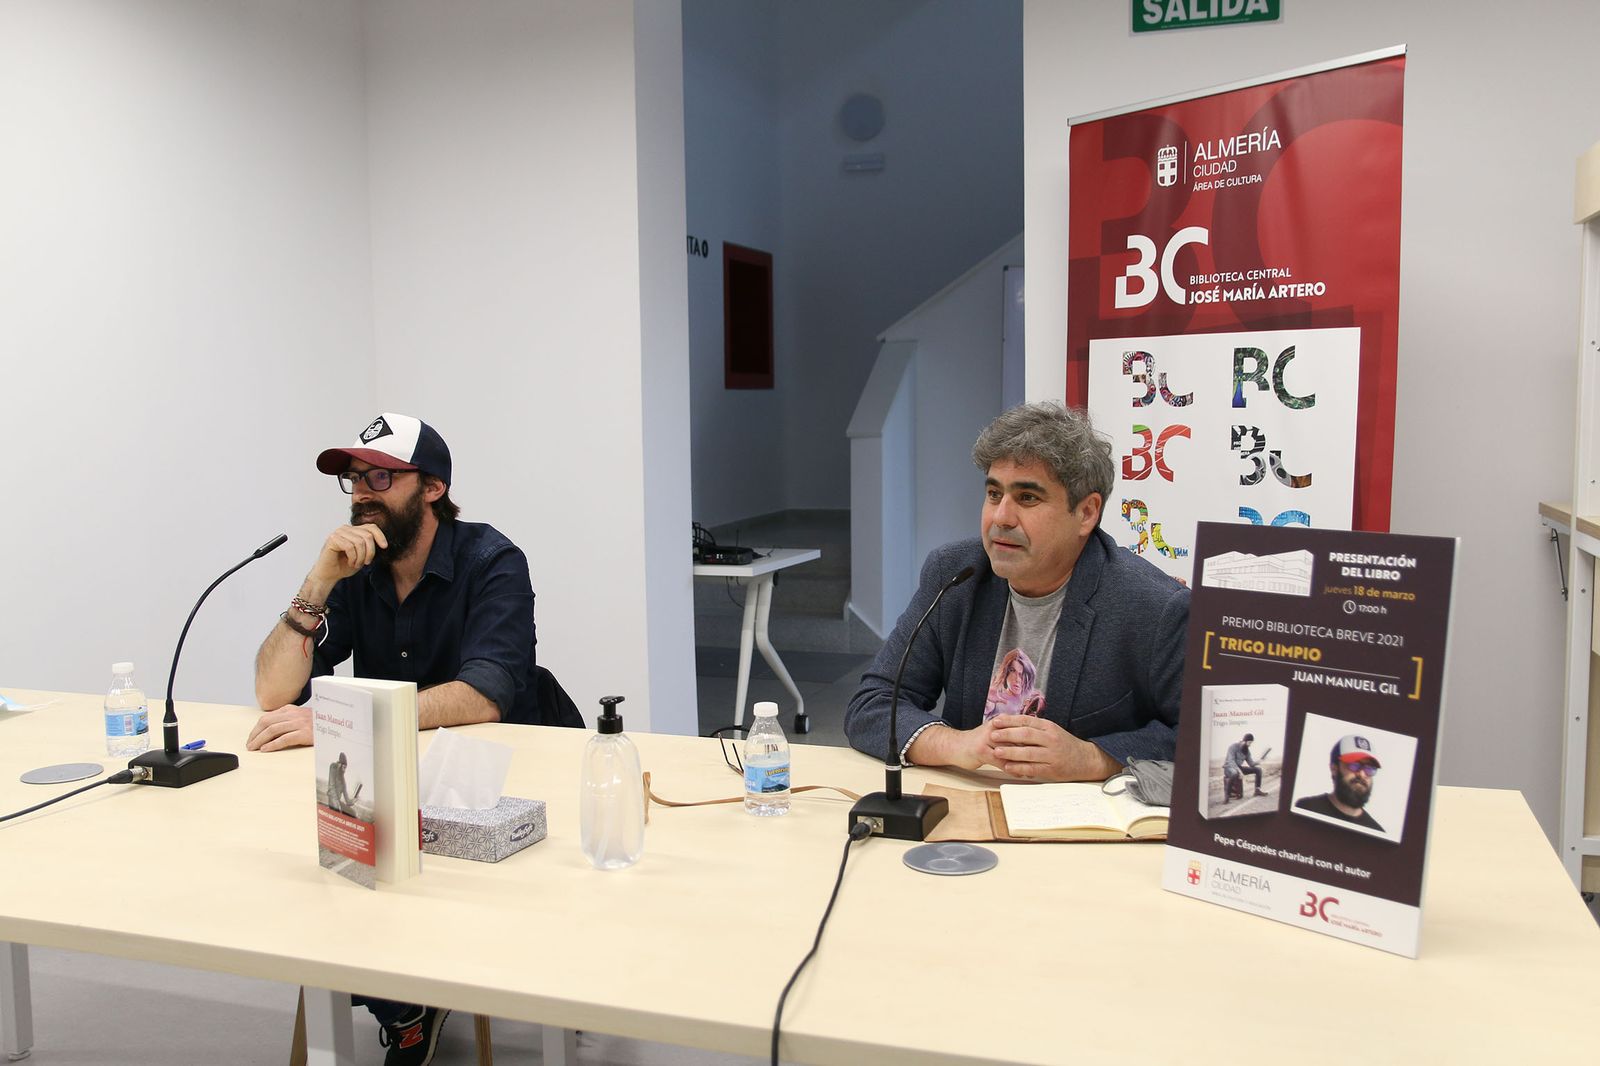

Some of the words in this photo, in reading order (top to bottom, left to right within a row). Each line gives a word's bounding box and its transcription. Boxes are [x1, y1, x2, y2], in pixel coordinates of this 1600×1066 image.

[1142, 0, 1269, 24] SALIDA
[1193, 126, 1282, 163] ALMERÍA
[1192, 160, 1237, 178] CIUDAD
[1192, 181, 1213, 192] ÁREA
[1214, 180, 1225, 189] DE
[1226, 174, 1263, 187] CULTURA
[687, 235, 701, 256] TA
[1189, 271, 1245, 285] BIBLIOTECA
[1246, 267, 1292, 281] CENTRAL
[1189, 286, 1220, 305] JOSÉ
[1223, 282, 1266, 302] MARÍA
[1267, 281, 1327, 300] ARTERO
[1328, 551, 1417, 568] PRESENTACIÓN
[1341, 566, 1363, 577] DEL
[1364, 568, 1401, 581] LIBRO
[1323, 584, 1352, 595] jueves
[1353, 585, 1365, 596] 18
[1366, 587, 1380, 598] de
[1382, 590, 1416, 601] marzo
[1380, 605, 1388, 615] h
[1222, 615, 1264, 631] PREMIO
[1266, 620, 1334, 639] BIBLIOTECA
[1336, 628, 1375, 644] BREVE
[1376, 633, 1404, 647] 2021
[1219, 636, 1265, 654] TRIGO
[1267, 642, 1322, 662] LIMPIO
[1292, 670, 1323, 684] JUAN
[1325, 675, 1377, 692] MANUEL
[1379, 682, 1400, 696] GIL
[1214, 832, 1235, 846] Pepe
[1236, 838, 1277, 856] Céspedes
[1278, 849, 1314, 865] charlará
[1315, 860, 1333, 870] con
[1334, 862, 1344, 873] el
[1344, 866, 1372, 879] autor
[1213, 867, 1271, 893] ALMERÍA
